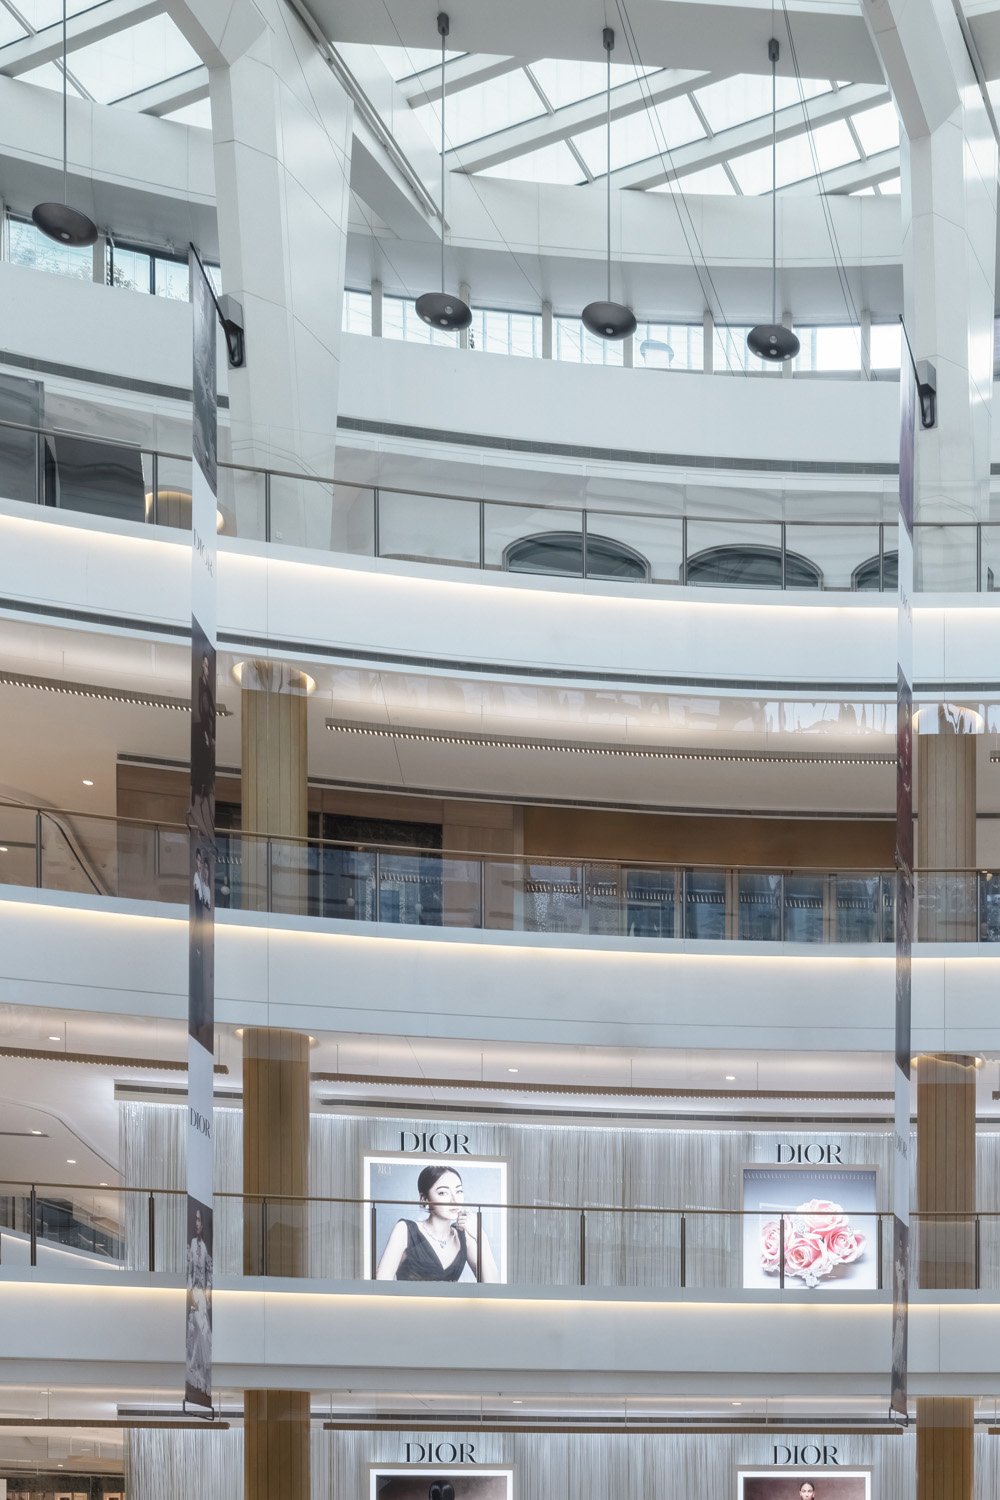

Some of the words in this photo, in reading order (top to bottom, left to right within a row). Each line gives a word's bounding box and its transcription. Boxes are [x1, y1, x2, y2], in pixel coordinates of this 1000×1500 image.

[190, 1107, 211, 1139] DIOR
[398, 1131, 472, 1155] DIOR
[776, 1143, 844, 1164] DIOR
[404, 1442, 477, 1463] DIOR
[773, 1444, 839, 1465] DIOR
